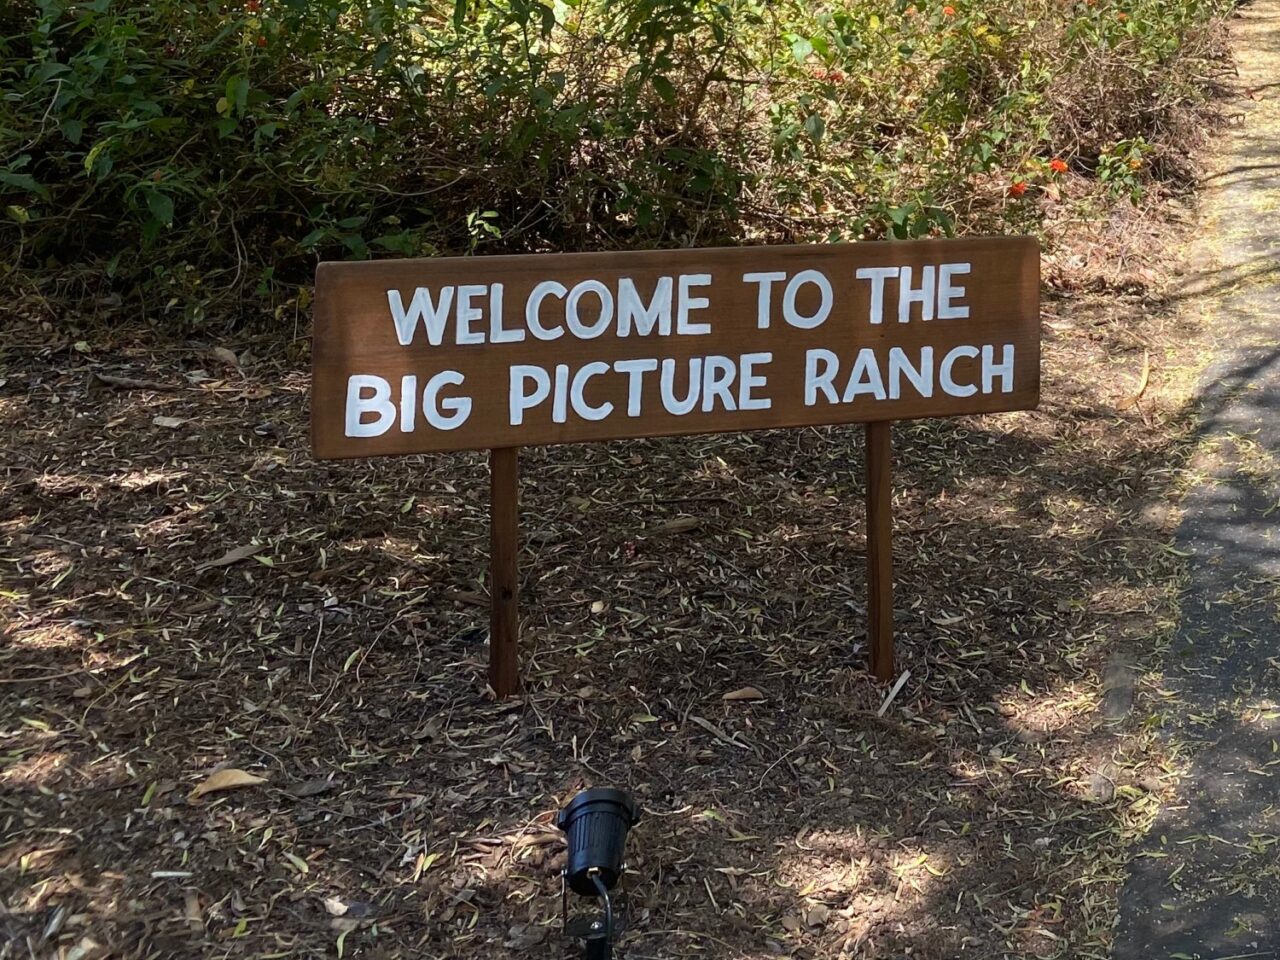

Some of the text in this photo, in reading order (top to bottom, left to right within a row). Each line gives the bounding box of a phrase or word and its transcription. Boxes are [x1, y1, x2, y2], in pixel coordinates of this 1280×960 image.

[387, 262, 971, 347] WELCOME TO THE
[345, 344, 1015, 438] BIG PICTURE RANCH
